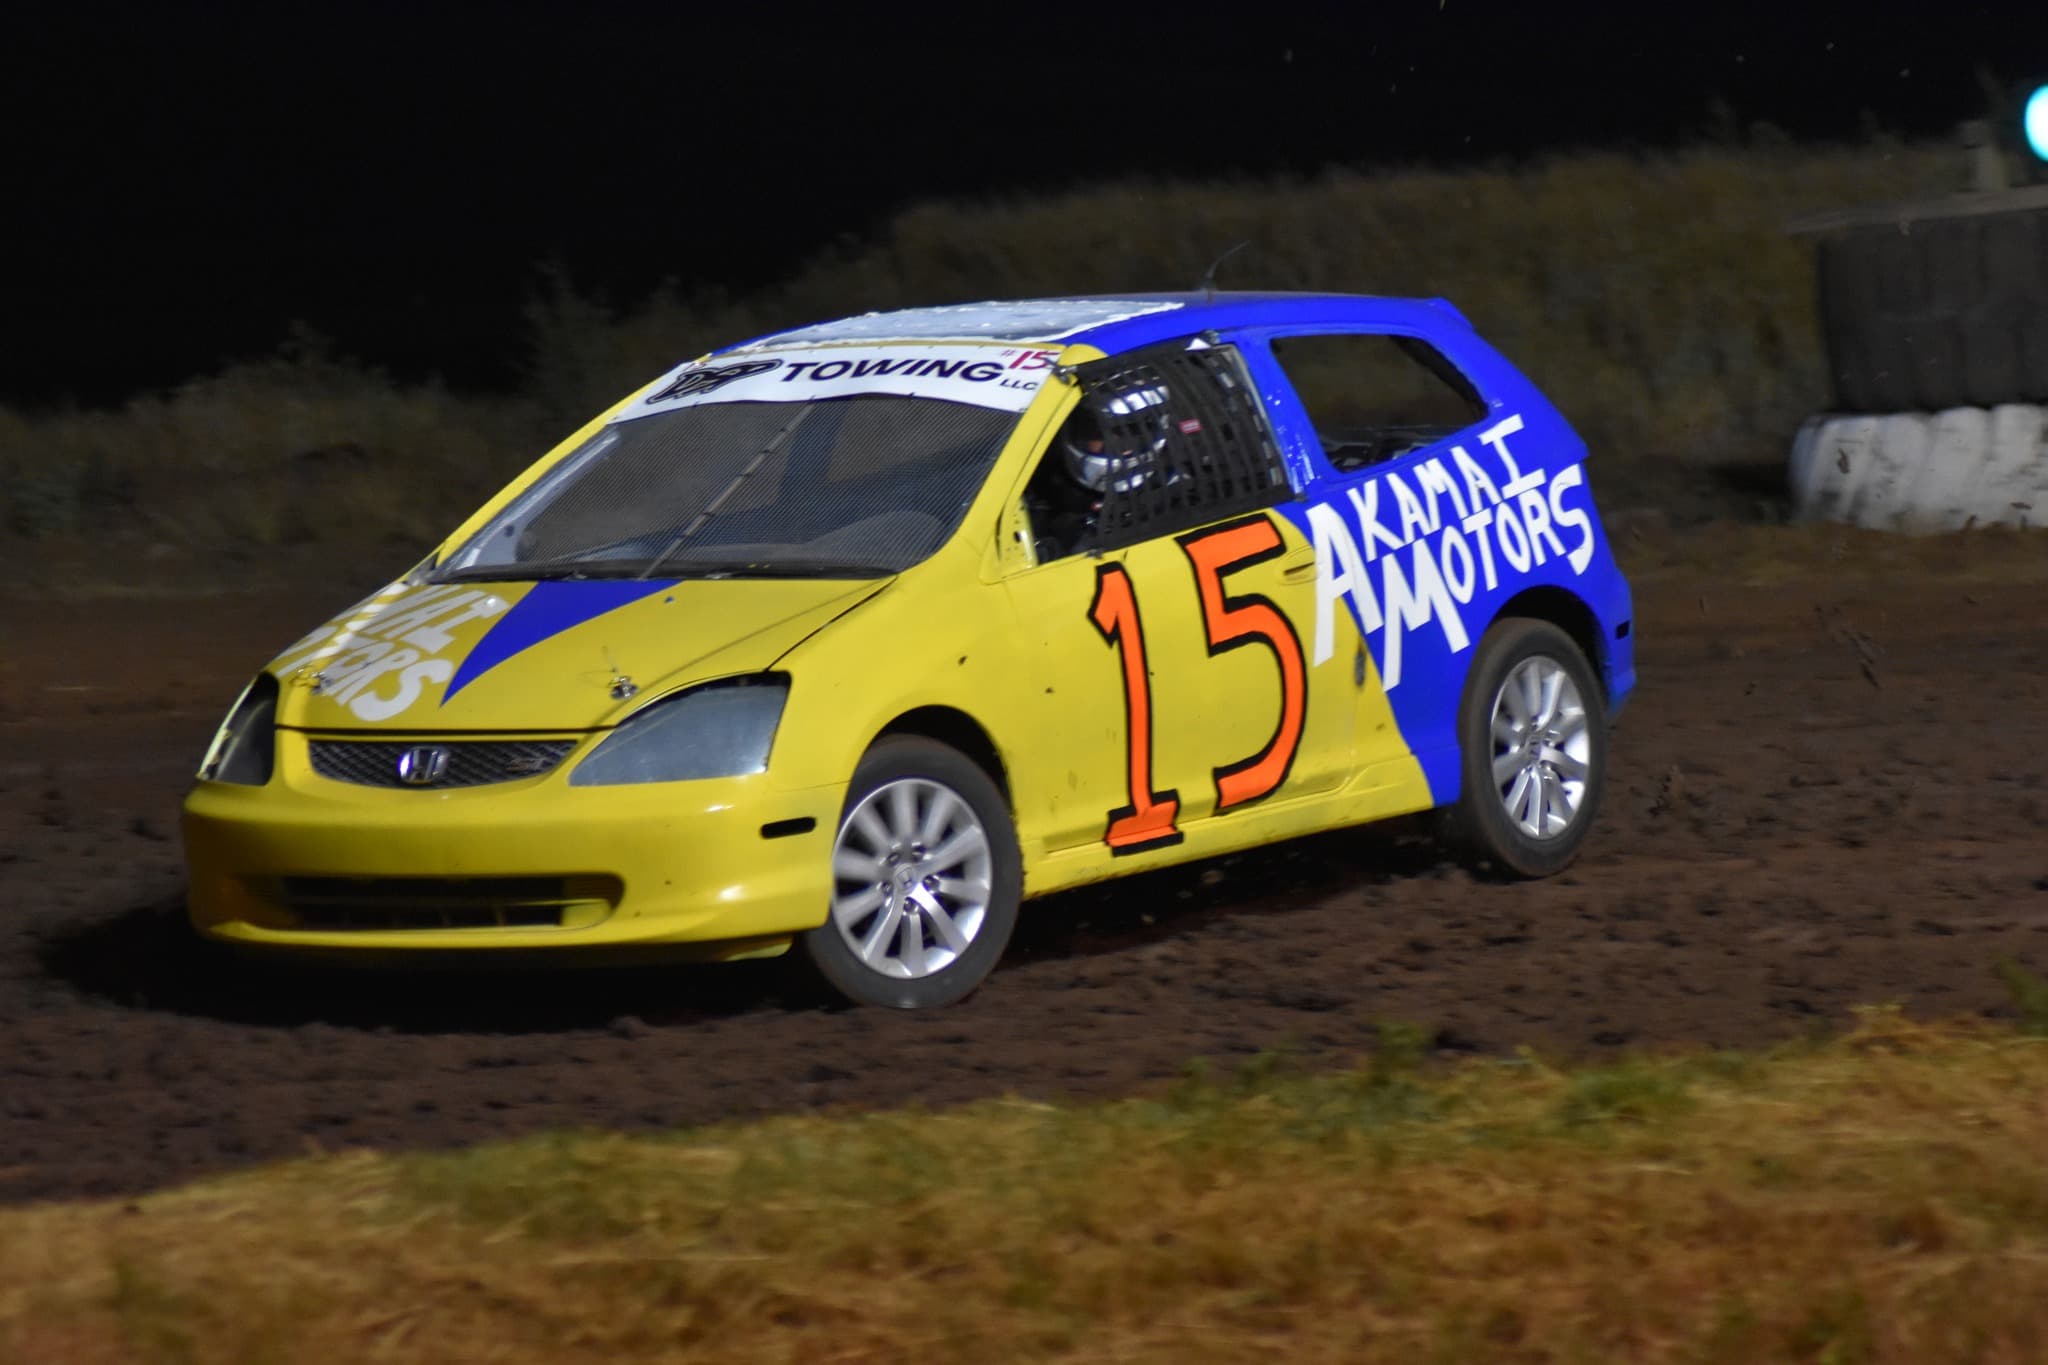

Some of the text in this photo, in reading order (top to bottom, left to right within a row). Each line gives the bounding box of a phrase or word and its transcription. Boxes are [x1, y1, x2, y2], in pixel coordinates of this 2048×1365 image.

[782, 359, 1004, 382] TOWING
[999, 379, 1038, 390] LLC
[1306, 414, 1546, 667] AKAMAI
[1382, 463, 1594, 692] MOTORS
[1086, 512, 1308, 857] 15
